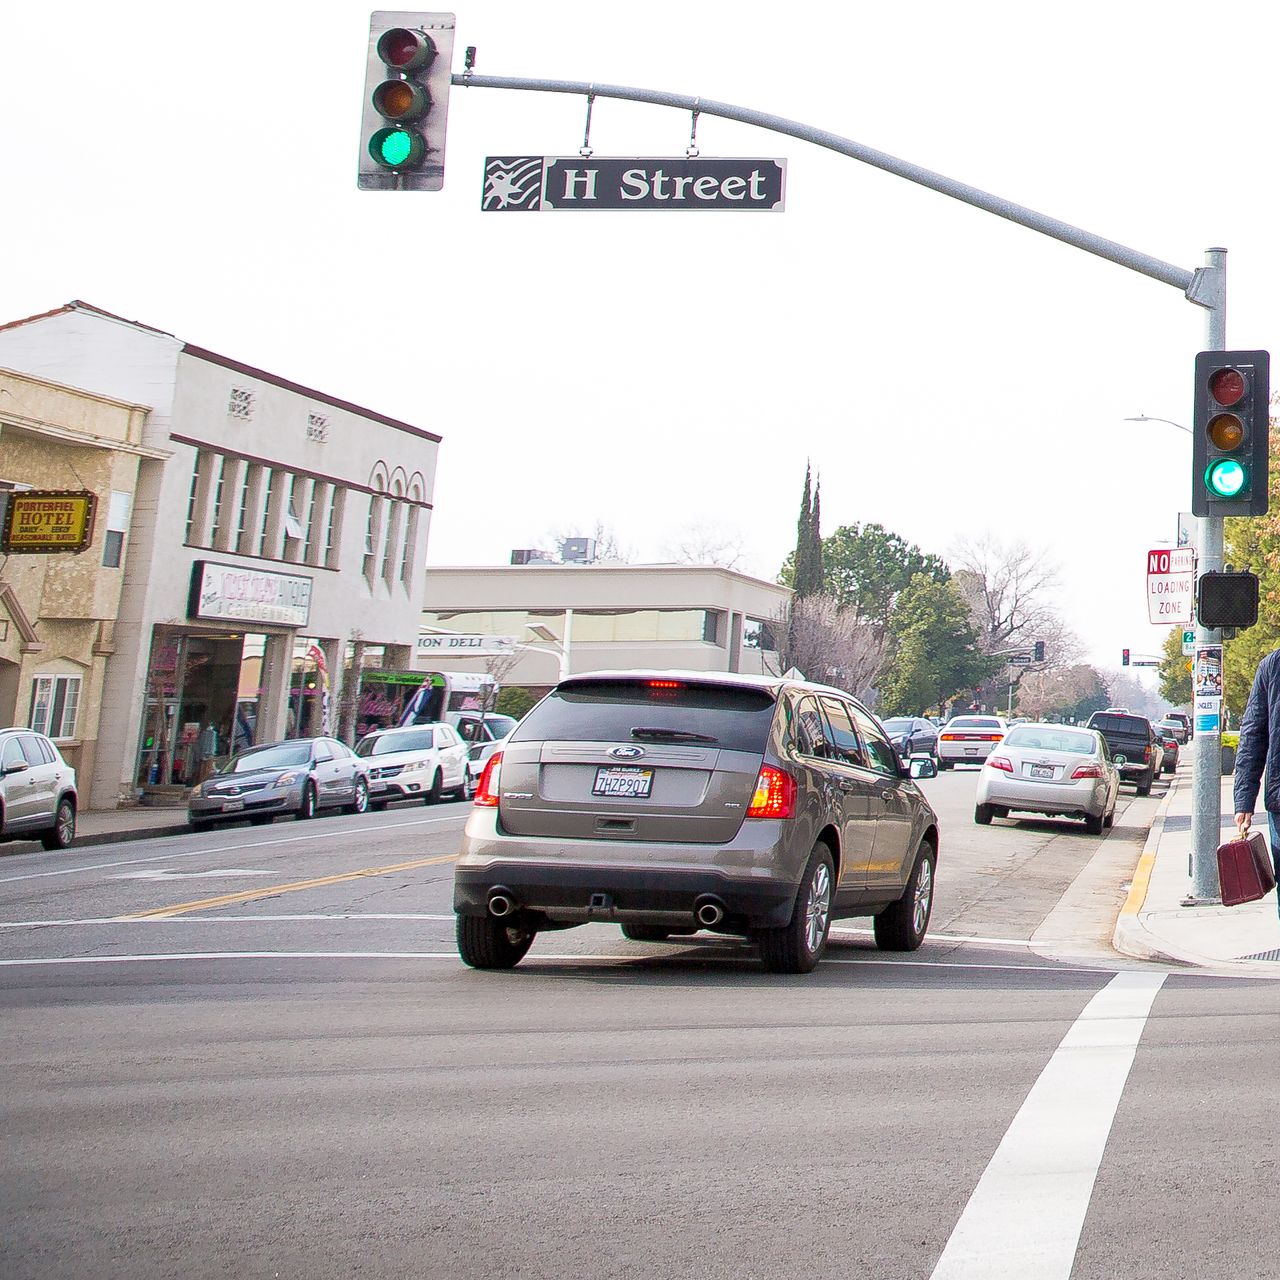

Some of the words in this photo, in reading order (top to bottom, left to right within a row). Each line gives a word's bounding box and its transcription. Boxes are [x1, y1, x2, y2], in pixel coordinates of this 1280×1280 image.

[563, 169, 599, 200] H
[620, 169, 768, 201] Street
[20, 512, 75, 525] HOTEL
[1149, 554, 1169, 573] NO
[1151, 580, 1189, 594] LOADING
[1159, 601, 1182, 614] ZONE
[448, 638, 483, 647] DELI
[1185, 632, 1192, 642] 2
[598, 777, 648, 793] 7HZP907
